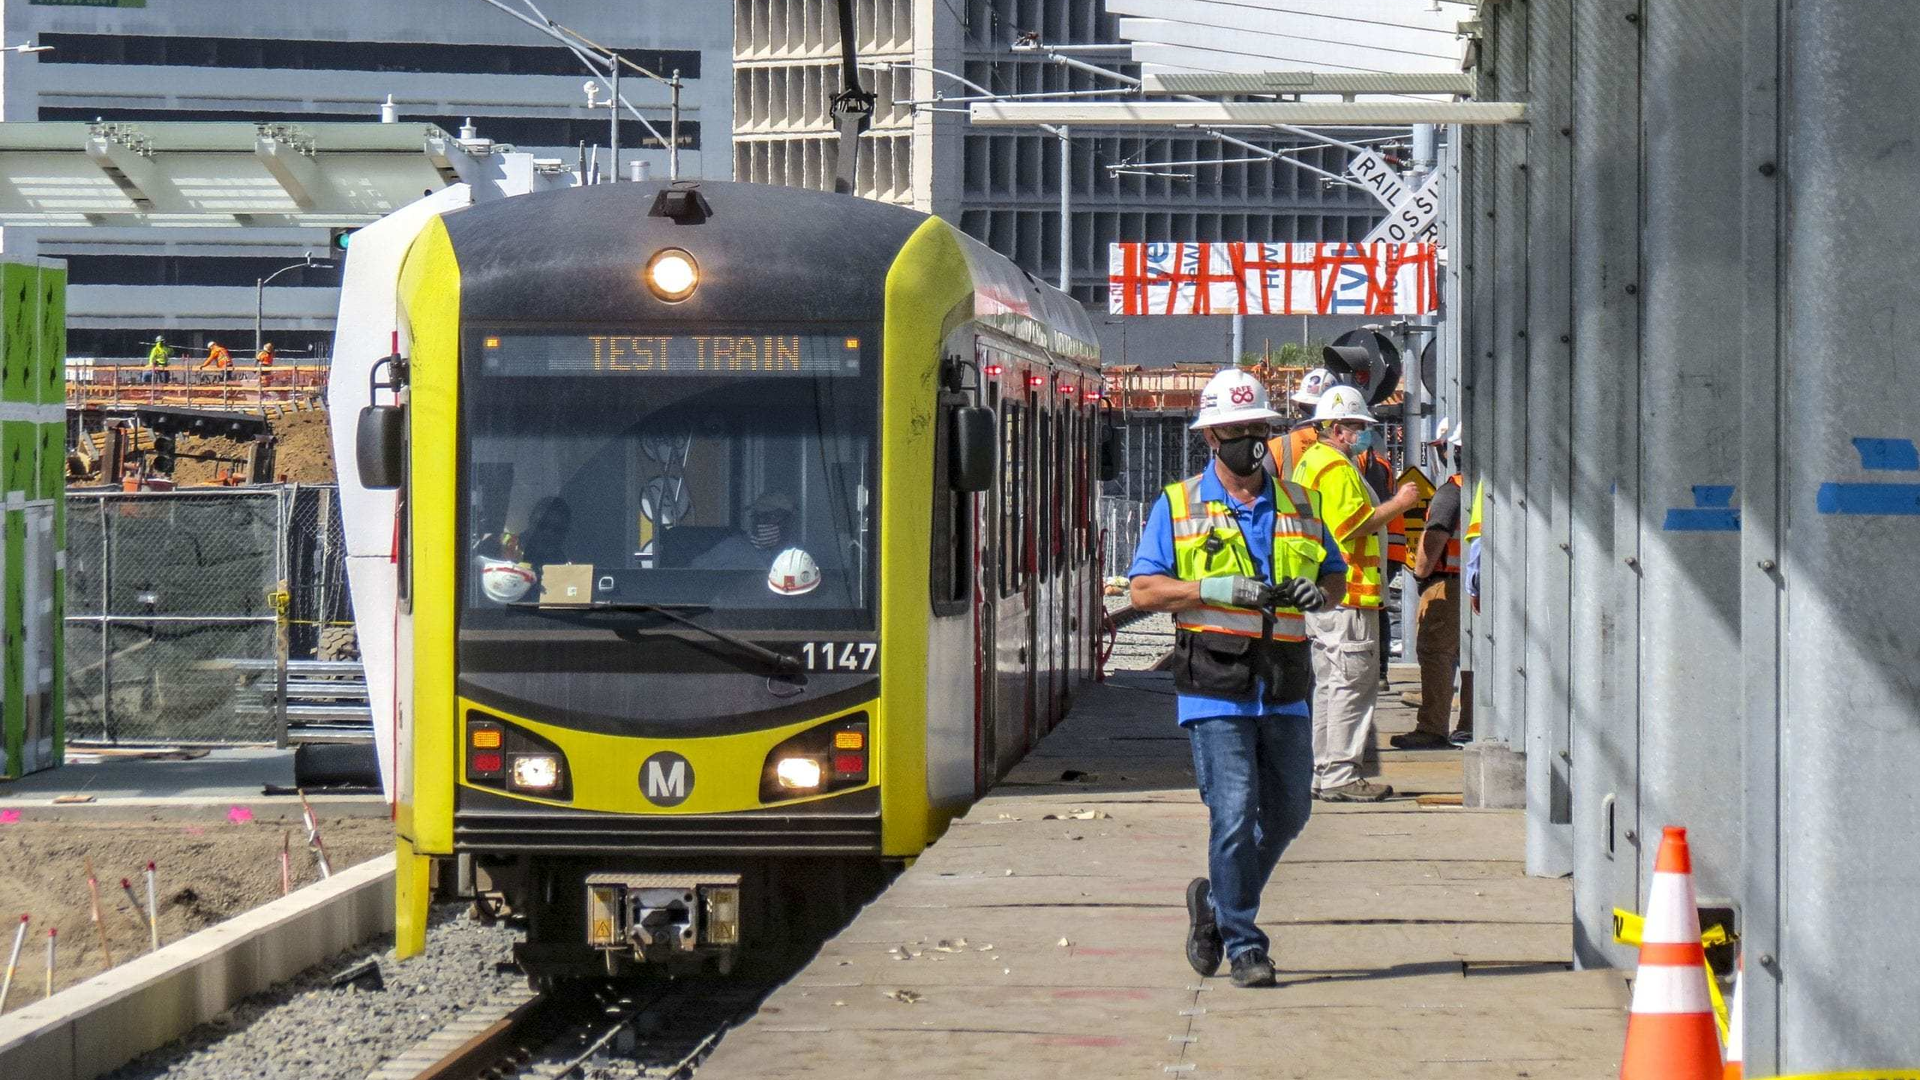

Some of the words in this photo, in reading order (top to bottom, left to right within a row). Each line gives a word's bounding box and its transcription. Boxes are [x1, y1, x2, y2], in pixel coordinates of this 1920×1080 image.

[1357, 156, 1401, 207] RAIL
[1373, 180, 1438, 243] OSSI
[588, 336, 673, 371] TEST
[692, 336, 799, 371] TRAIN
[802, 643, 877, 670] 1147
[648, 761, 685, 797] M
